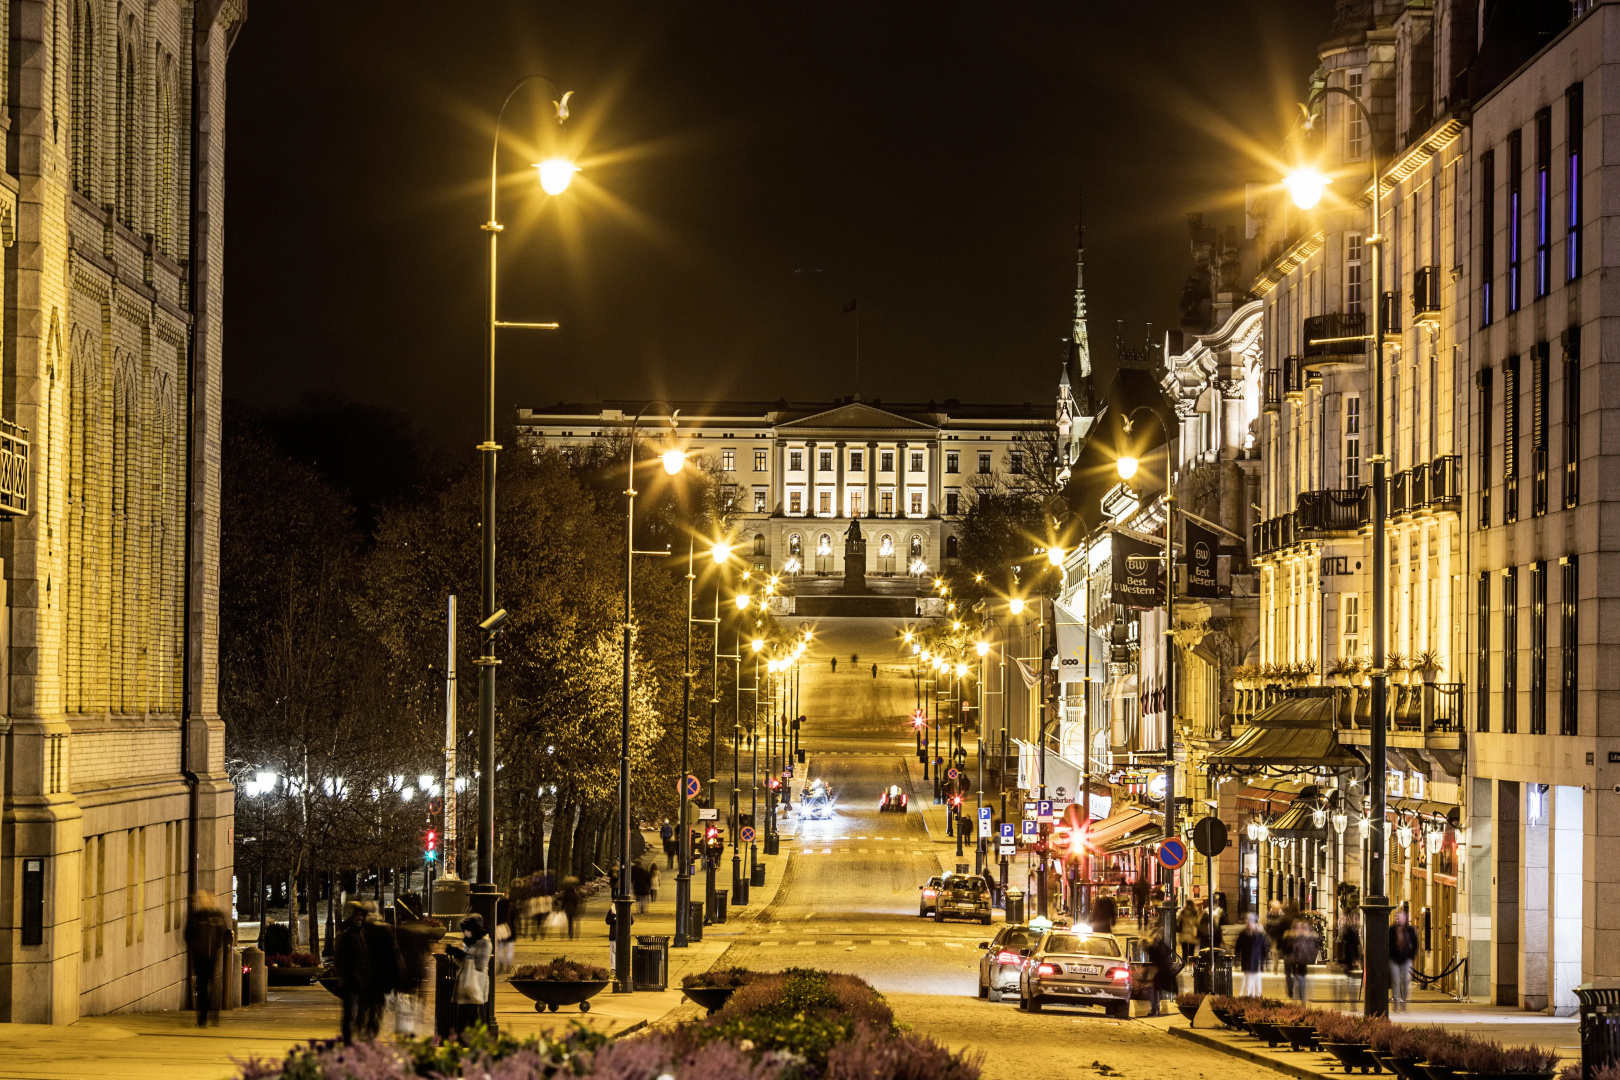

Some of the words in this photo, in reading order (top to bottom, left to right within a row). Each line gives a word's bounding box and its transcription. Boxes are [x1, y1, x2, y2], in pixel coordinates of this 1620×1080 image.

[1196, 549, 1208, 559] BW
[1128, 560, 1146, 570] BW
[1320, 556, 1354, 576] HOTEL
[1127, 576, 1148, 587] Best
[1120, 583, 1155, 594] Western
[981, 808, 988, 819] P
[1040, 801, 1050, 815] P
[1003, 825, 1012, 836] P
[1025, 821, 1034, 834] P
